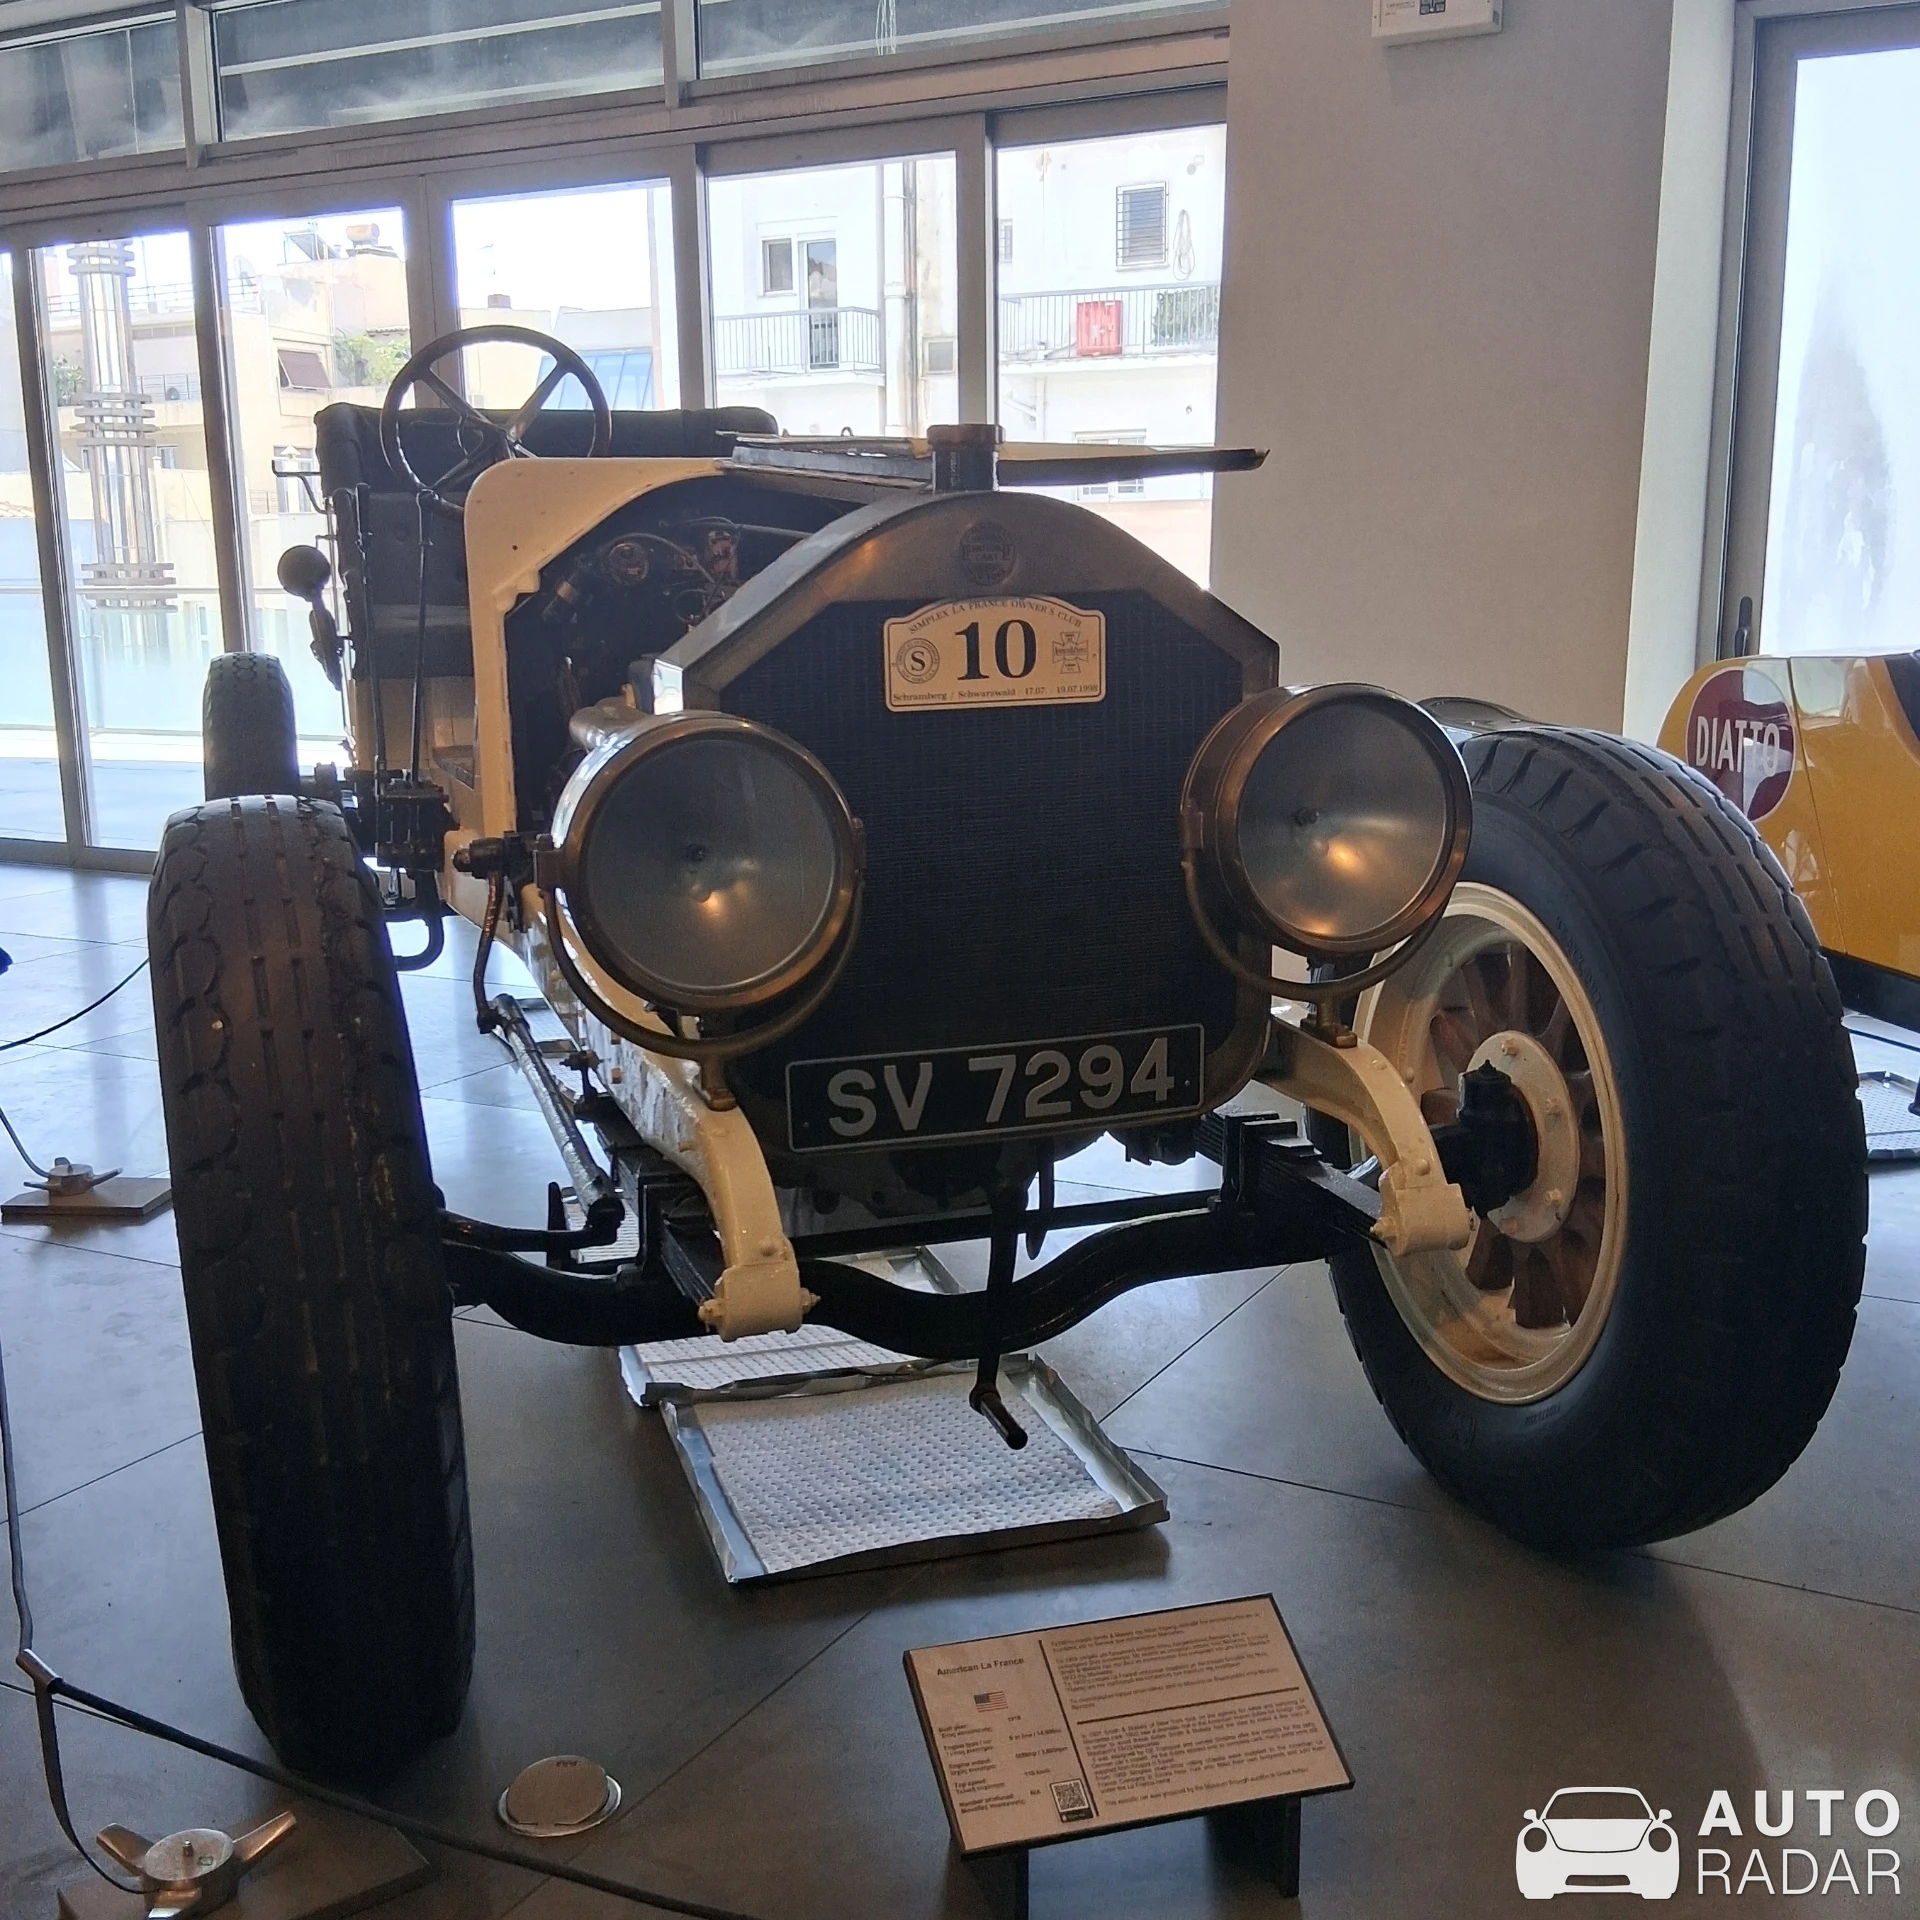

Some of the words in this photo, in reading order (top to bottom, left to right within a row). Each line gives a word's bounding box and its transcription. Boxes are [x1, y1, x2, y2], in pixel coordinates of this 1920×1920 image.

[908, 610, 949, 634] SIMPLEX
[952, 603, 965, 615] LA
[968, 600, 1007, 610] FRANCE
[1057, 611, 1082, 628] CLUB
[911, 650, 926, 672] S
[954, 619, 1037, 681] 10
[893, 691, 948, 701] Schramberg
[957, 687, 1016, 698] Schwarzwald
[1696, 715, 1780, 778] DIATTO
[827, 1061, 933, 1137] SV
[968, 1037, 1175, 1123] 7294
[937, 1663, 979, 1676] American
[980, 1661, 992, 1670] La
[994, 1657, 1024, 1668] France
